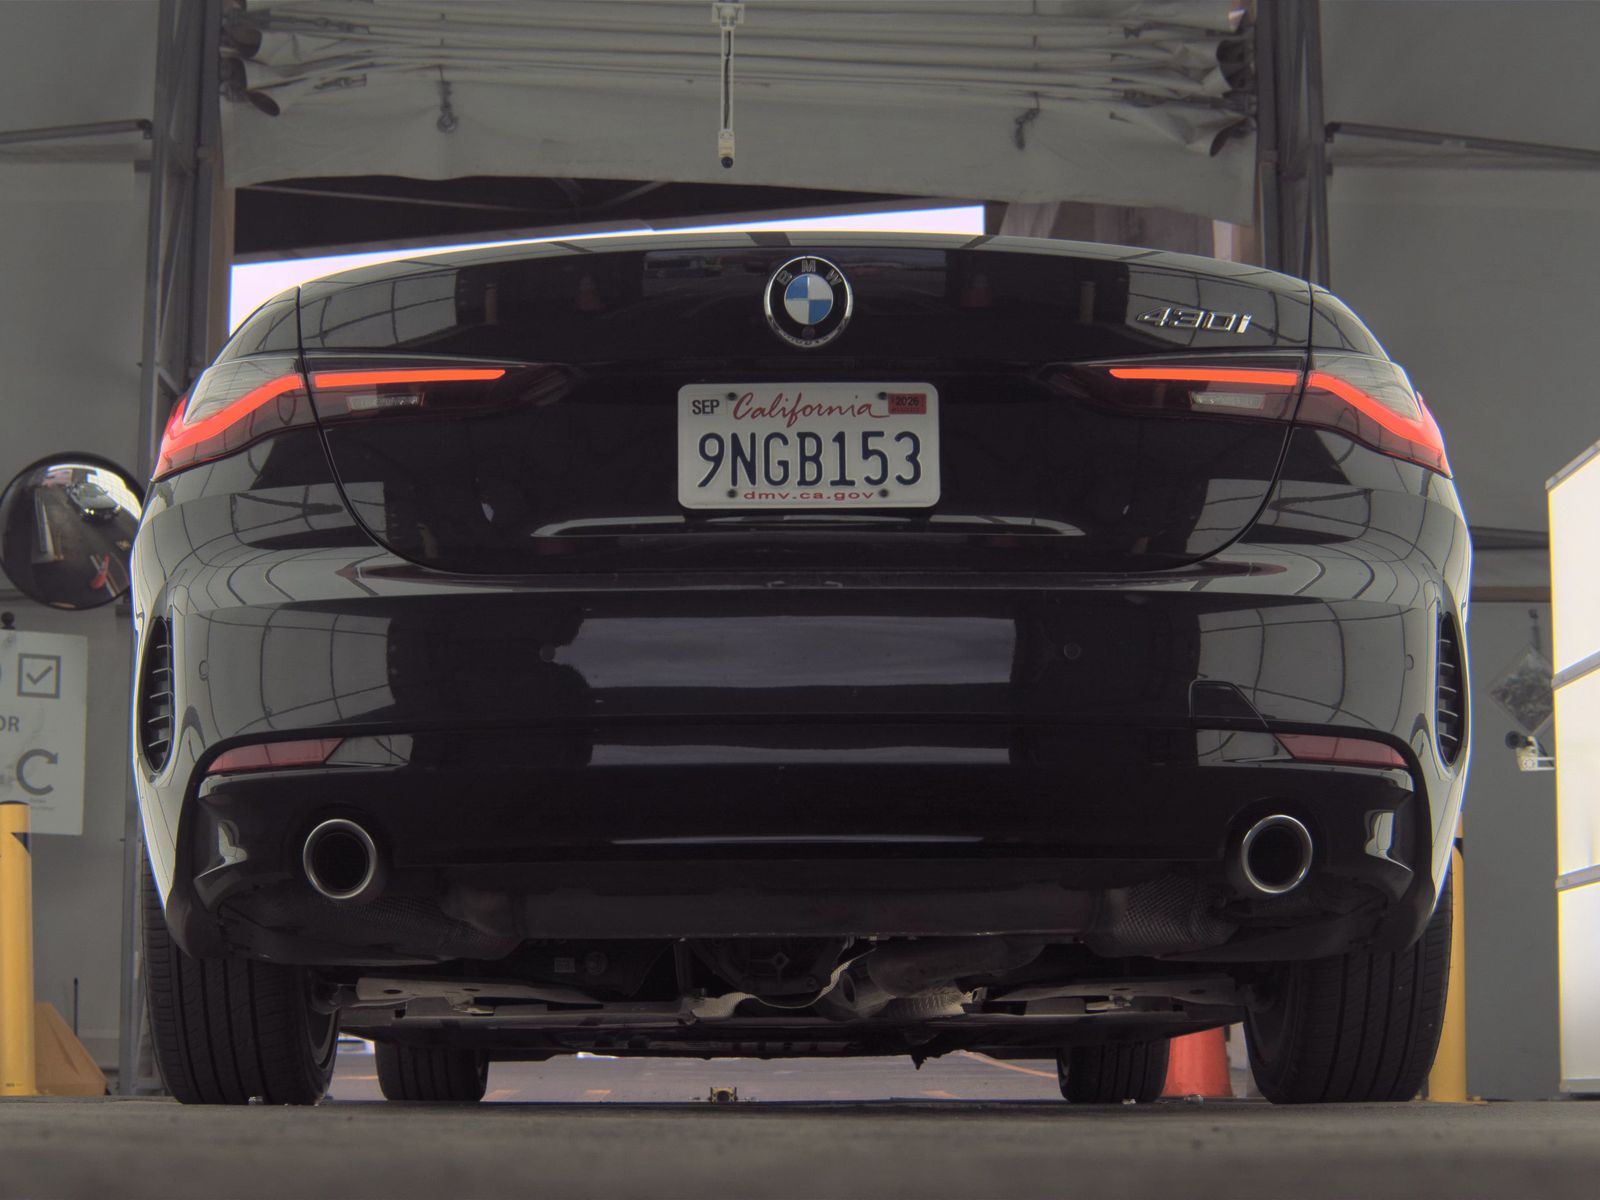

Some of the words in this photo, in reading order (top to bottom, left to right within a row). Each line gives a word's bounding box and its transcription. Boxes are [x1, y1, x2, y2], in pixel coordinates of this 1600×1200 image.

[776, 259, 842, 286] BMW
[1136, 307, 1252, 334] 430i
[692, 399, 720, 415] SEP
[732, 392, 891, 428] California
[698, 431, 922, 488] 9NGB153
[743, 489, 874, 501] dmv.ca.gov
